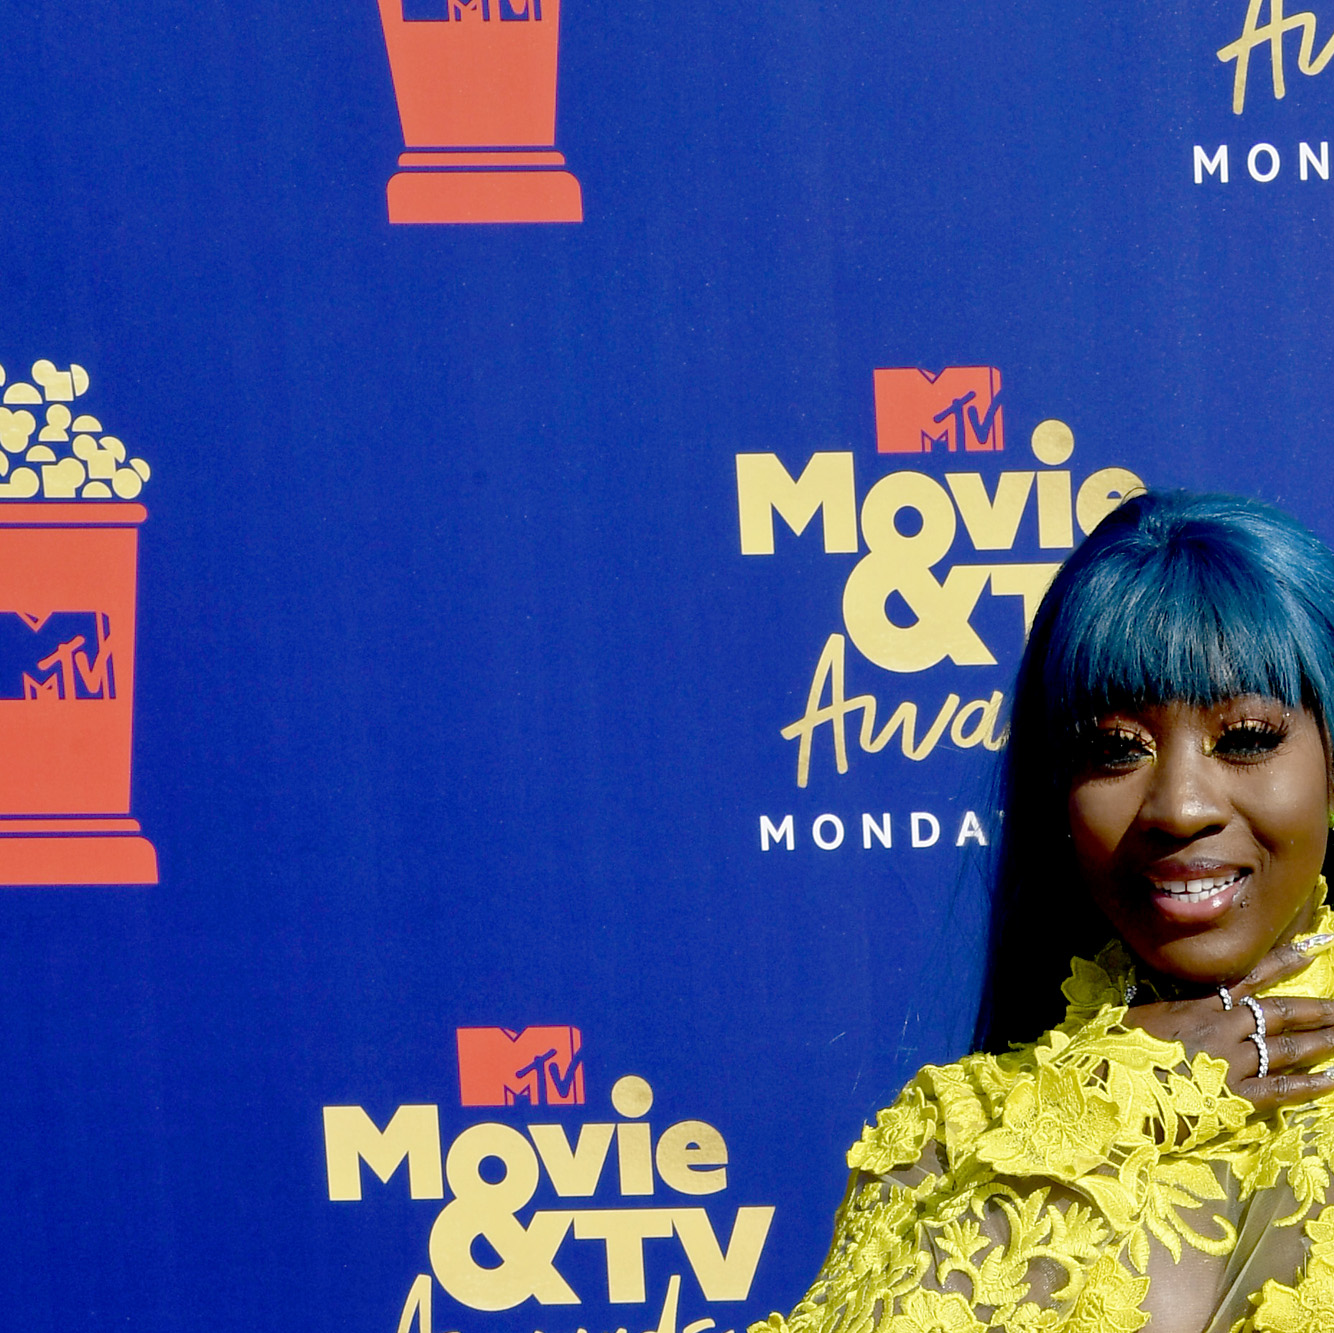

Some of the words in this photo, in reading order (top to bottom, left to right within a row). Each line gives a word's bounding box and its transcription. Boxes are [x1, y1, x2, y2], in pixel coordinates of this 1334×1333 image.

[873, 366, 1004, 454] MTV
[0, 611, 116, 700] MTV
[780, 633, 1009, 788] Awa
[759, 810, 988, 851] MONDA
[456, 1025, 585, 1107] MTV
[322, 1075, 728, 1202] Movie
